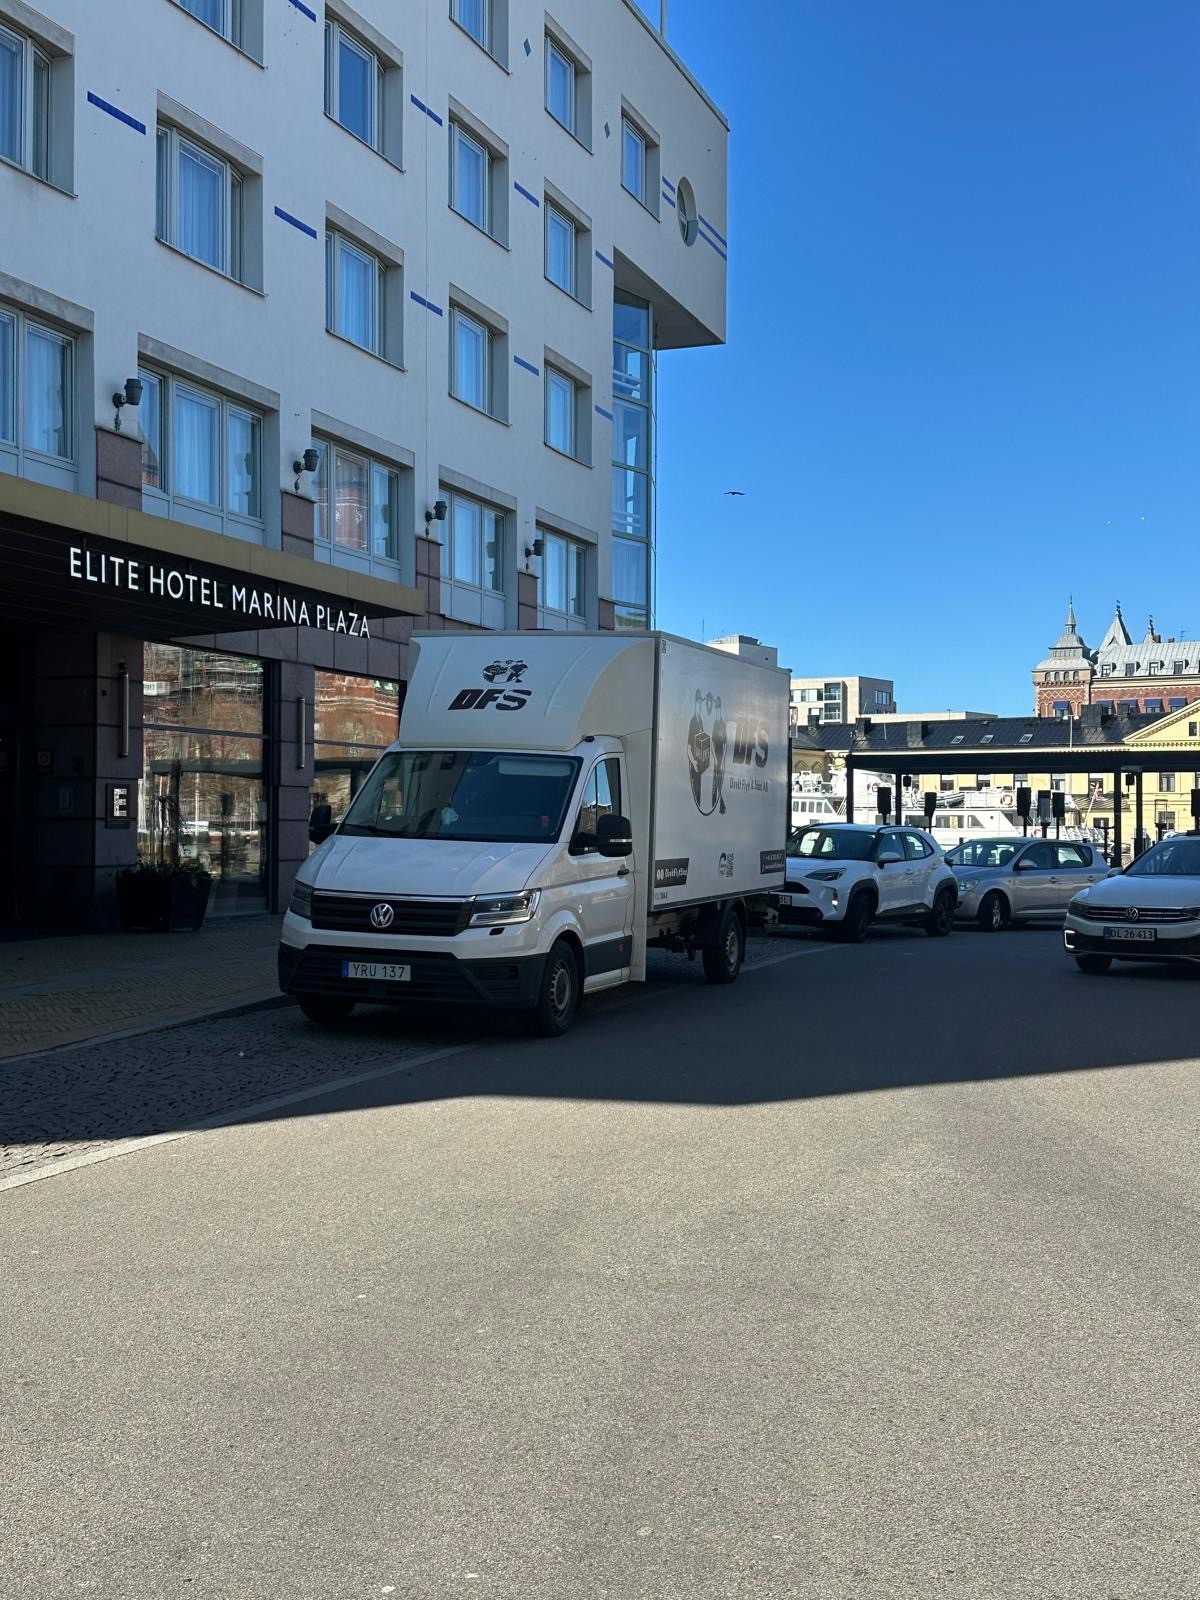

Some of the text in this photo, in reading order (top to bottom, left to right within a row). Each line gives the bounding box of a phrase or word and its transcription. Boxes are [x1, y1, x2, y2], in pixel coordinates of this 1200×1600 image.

[70, 547, 370, 638] ELITE HOTEL MARINA PLAZA
[448, 689, 532, 710] DFS
[733, 719, 769, 768] DFS
[1110, 929, 1153, 940] DL 26 413
[353, 964, 405, 979] YRU 137
